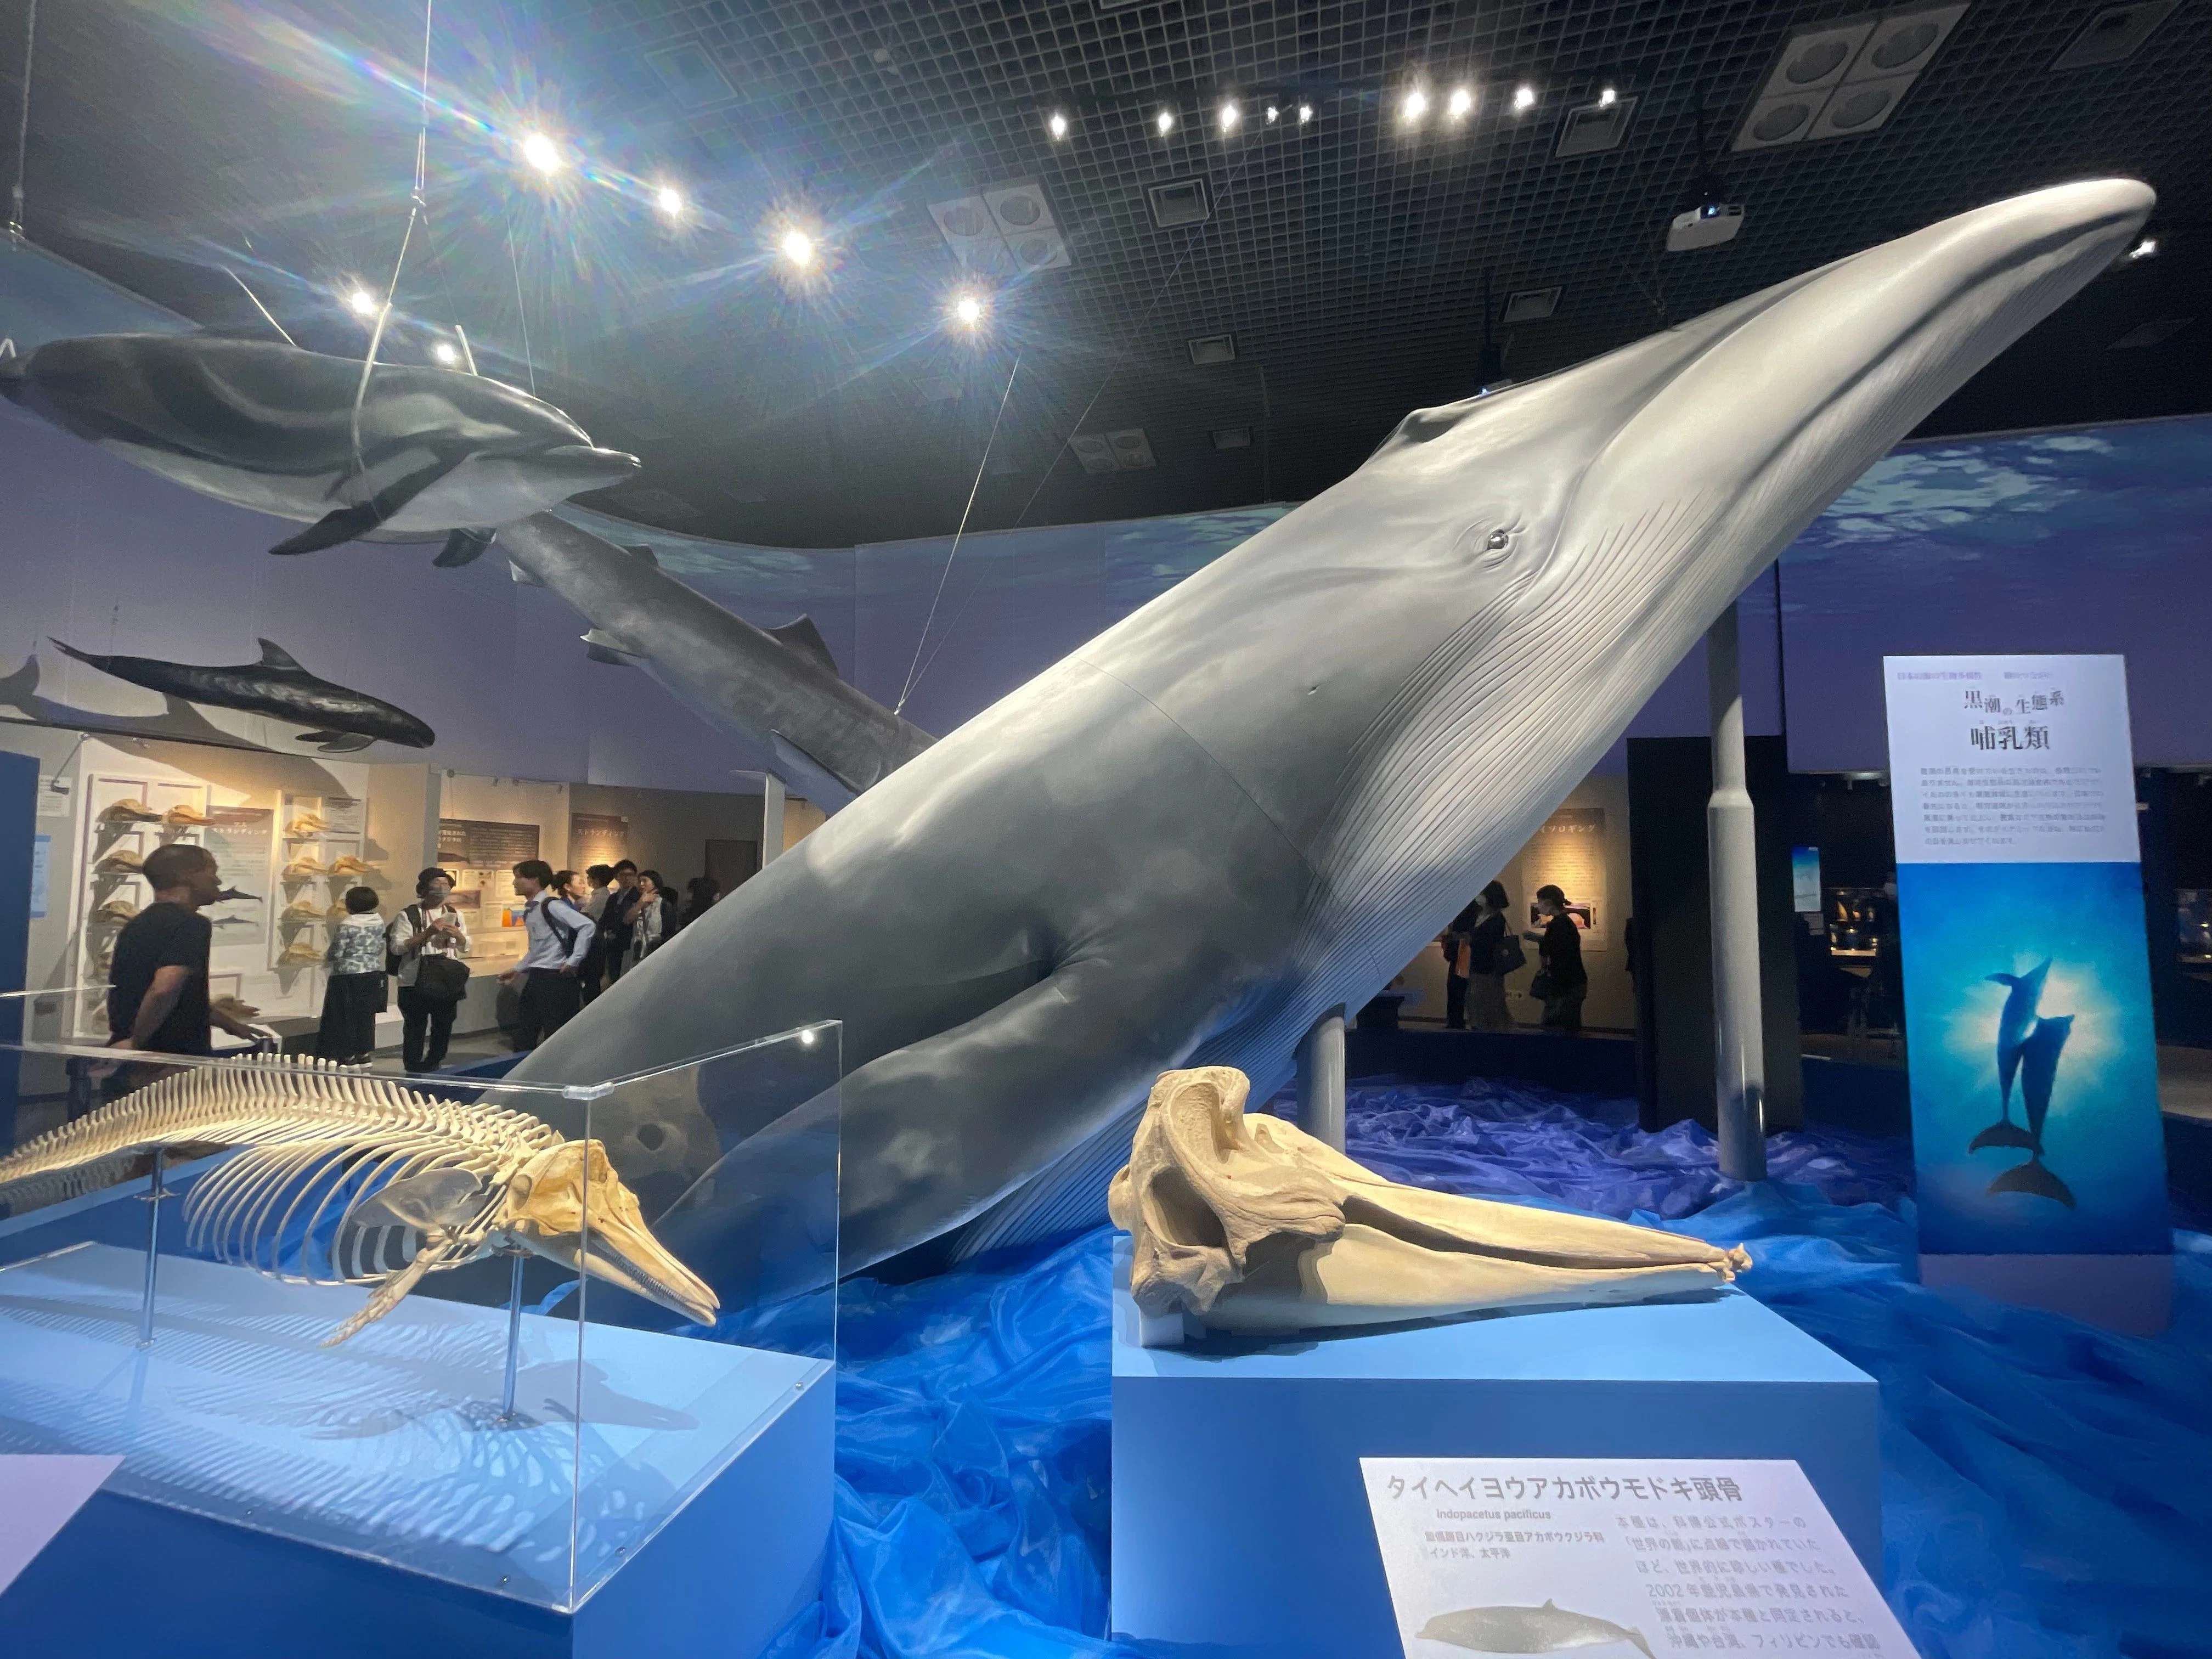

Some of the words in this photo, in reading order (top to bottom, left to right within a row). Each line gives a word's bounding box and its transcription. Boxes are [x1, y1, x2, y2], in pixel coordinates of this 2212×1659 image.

[1963, 690, 2064, 716] 黒潮の生態系
[1970, 725, 2050, 751] 哺乳類
[1539, 823, 1595, 833] イソロギング
[1387, 1475, 1742, 1502] タイヘイヨウアカボウモドキ頭骨
[1436, 1509, 1500, 1521] Indopacetus
[1504, 1509, 1551, 1521] pacificus
[1430, 1547, 1510, 1559] インド洋、太平洋
